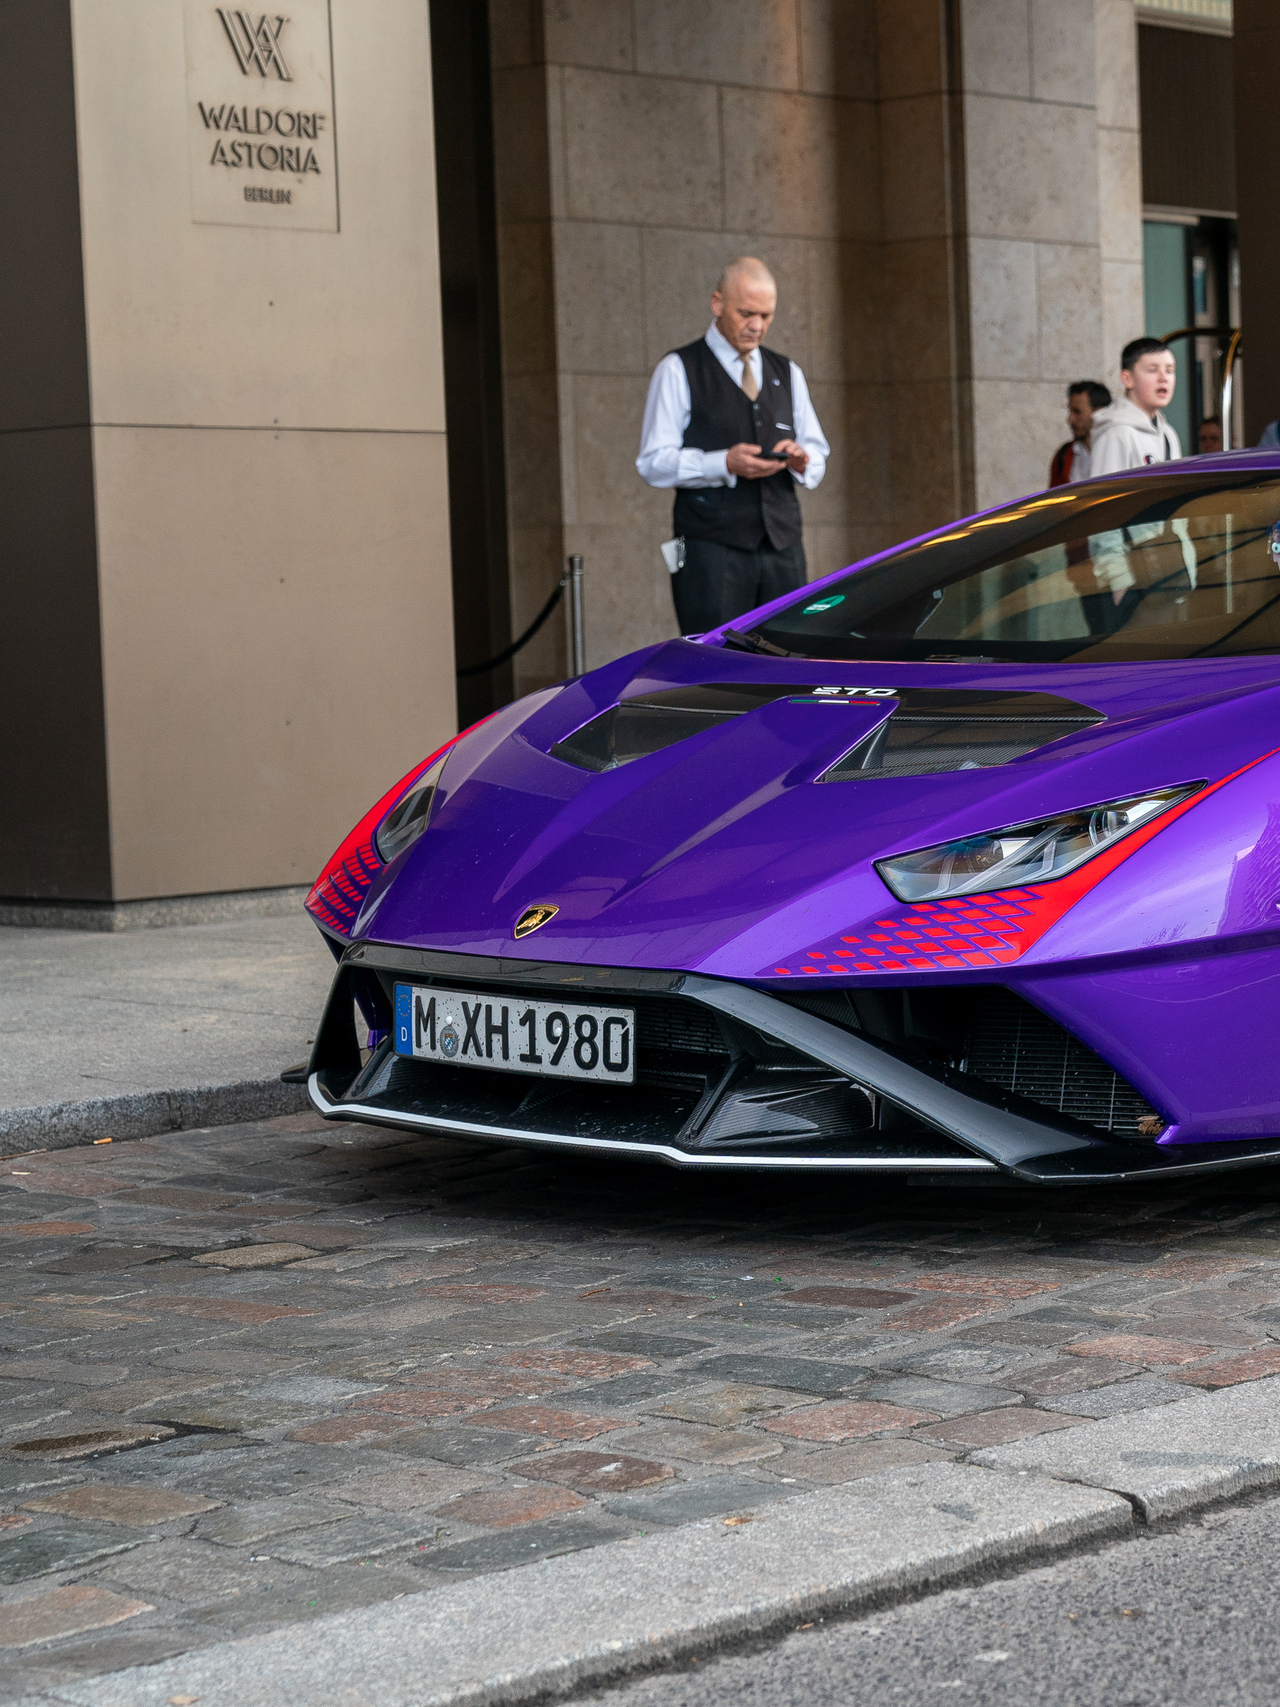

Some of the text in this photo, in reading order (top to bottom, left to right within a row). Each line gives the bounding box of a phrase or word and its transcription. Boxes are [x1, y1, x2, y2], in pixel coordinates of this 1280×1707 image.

[198, 101, 325, 139] WALDORF
[210, 139, 321, 175] ASTORIA
[244, 186, 291, 204] BERLIN
[812, 686, 898, 697] STO
[400, 1026, 408, 1042] D
[415, 995, 436, 1051] M
